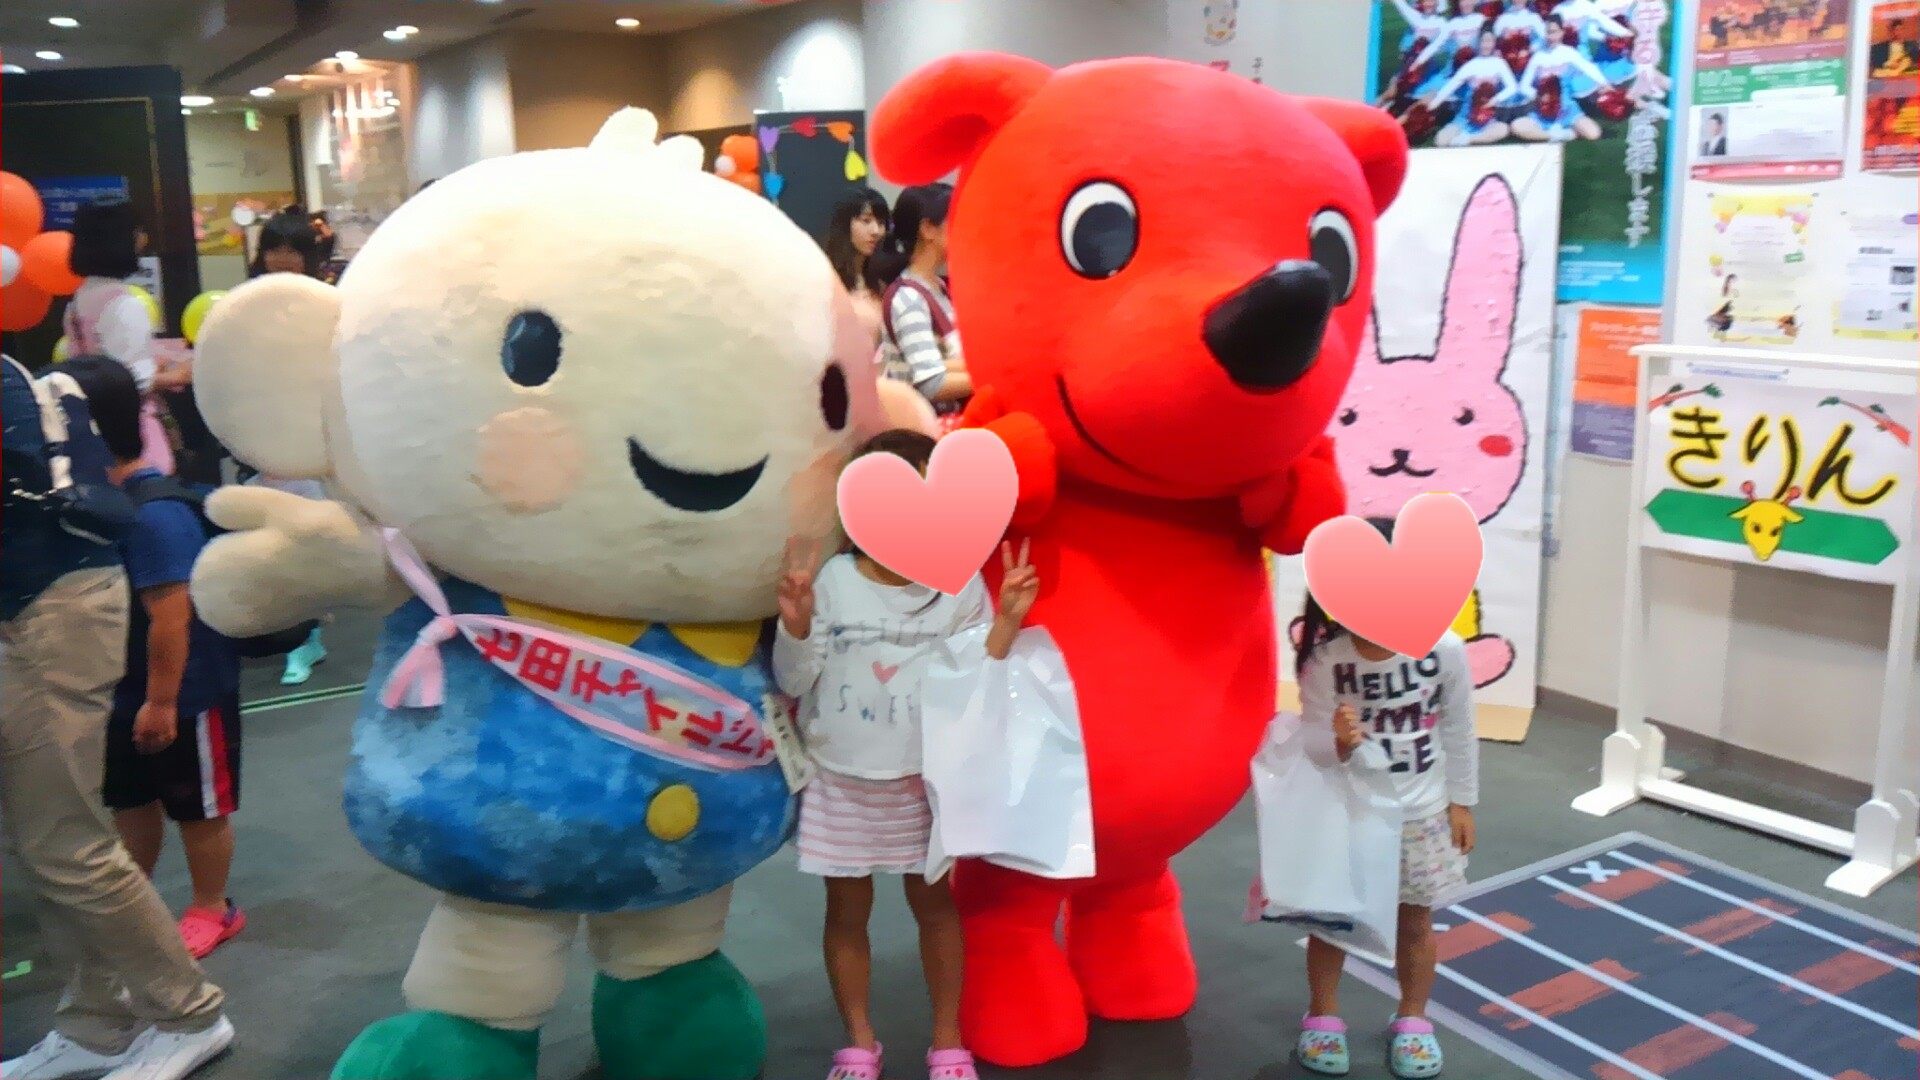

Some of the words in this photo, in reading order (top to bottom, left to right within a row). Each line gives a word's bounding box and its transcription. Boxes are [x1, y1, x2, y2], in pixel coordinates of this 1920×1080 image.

[1667, 406, 1896, 506] きりん
[1333, 651, 1440, 700] HELLO
